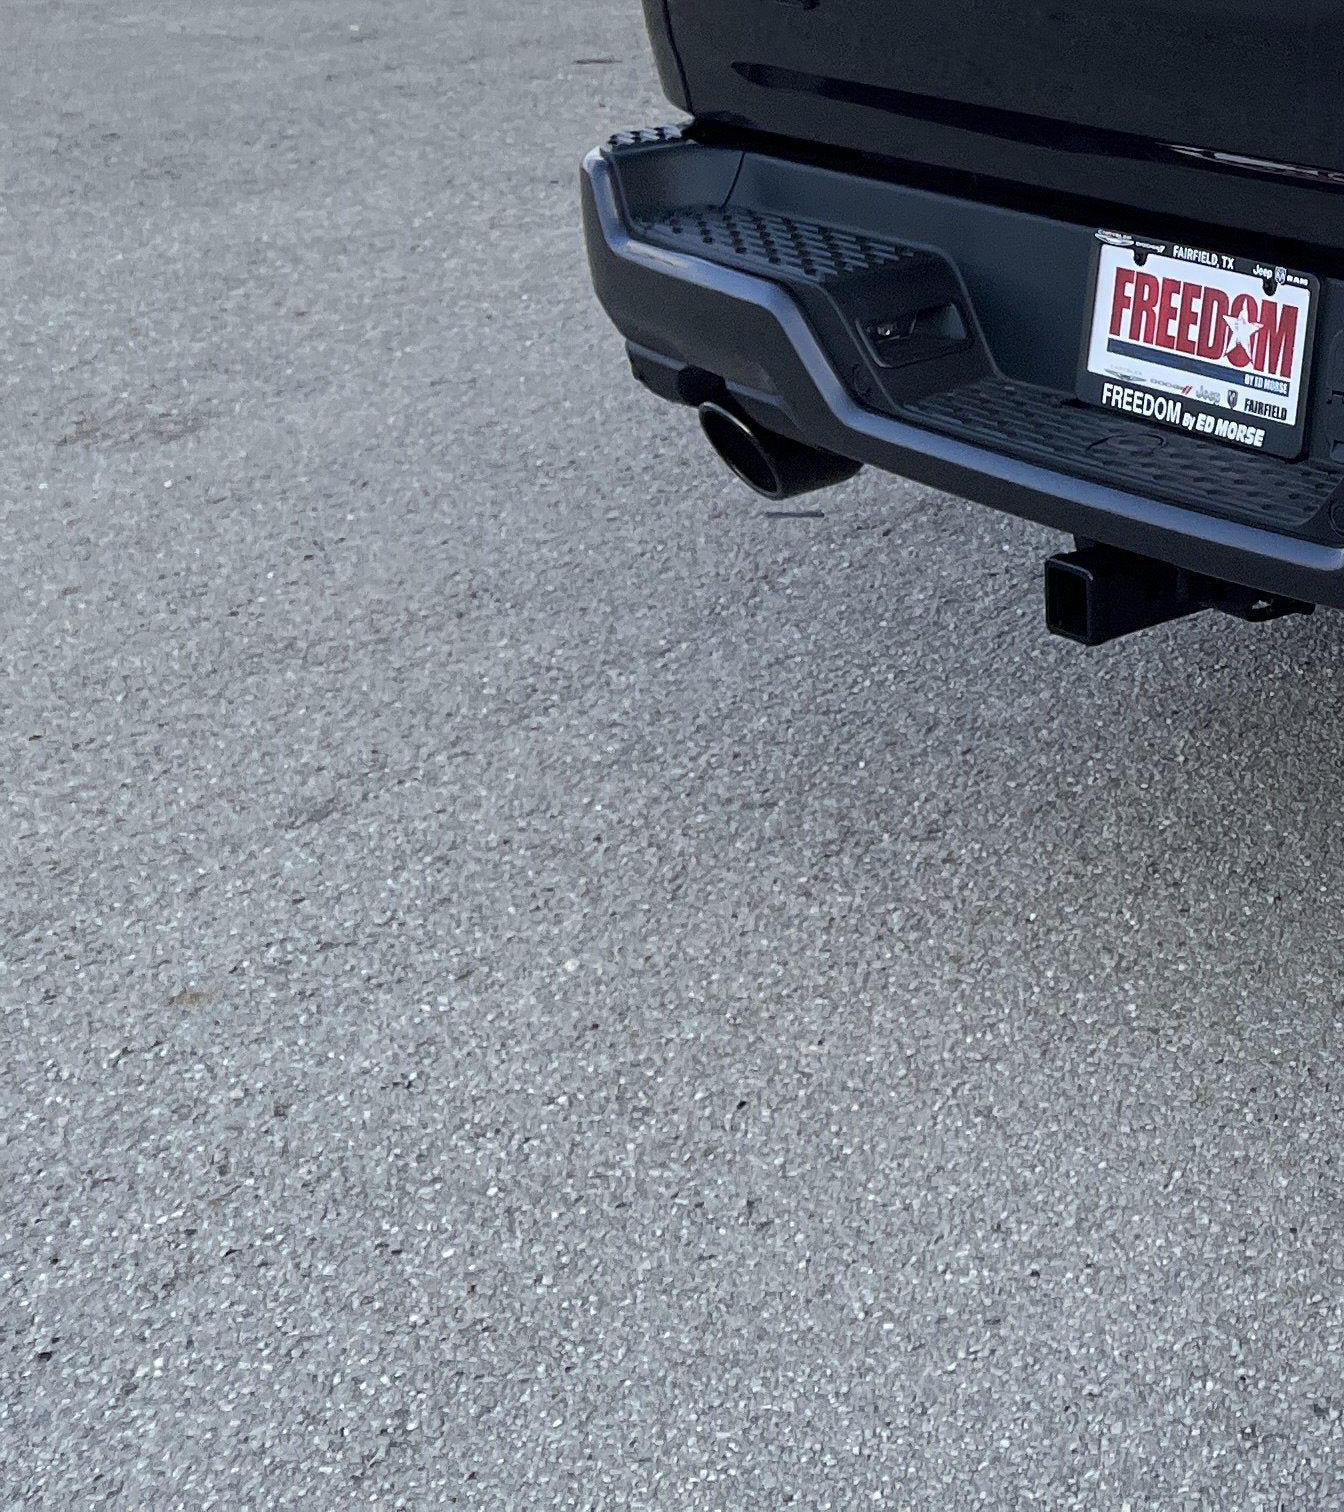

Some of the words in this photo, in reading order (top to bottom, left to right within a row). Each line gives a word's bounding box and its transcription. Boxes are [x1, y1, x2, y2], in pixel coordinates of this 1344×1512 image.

[1173, 245, 1220, 268] FAIRFIELD,
[1221, 255, 1235, 270] TX
[1252, 264, 1273, 280] Jeep
[1109, 267, 1299, 379] FREEDOM
[1101, 382, 1182, 425] FREEDOM
[1196, 413, 1215, 433] ED
[1214, 418, 1266, 448] MORSE
[1244, 398, 1288, 421] FAIRFIELD
